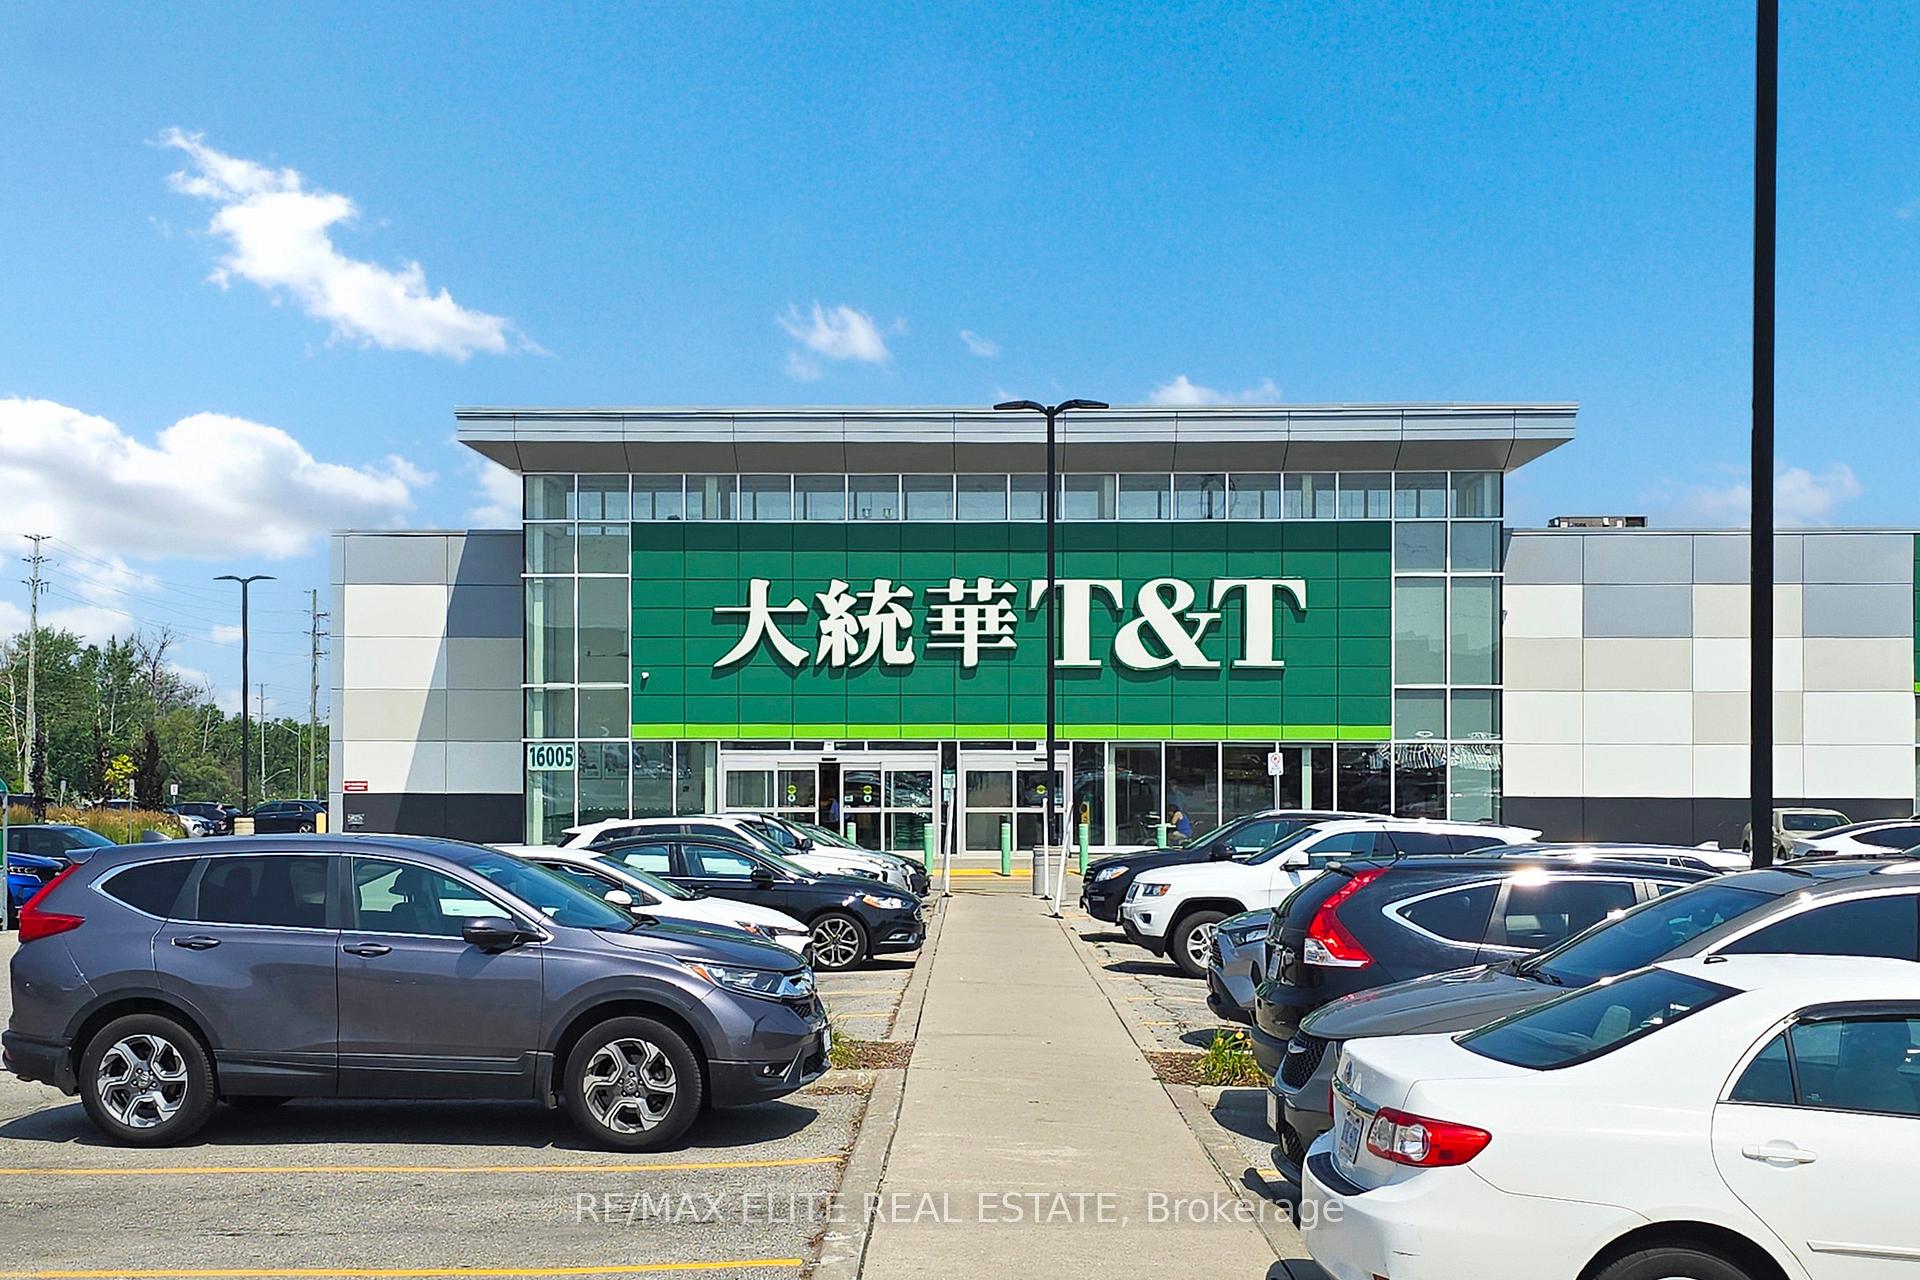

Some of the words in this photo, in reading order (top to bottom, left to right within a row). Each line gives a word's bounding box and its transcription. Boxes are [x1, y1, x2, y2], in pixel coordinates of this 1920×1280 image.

[713, 576, 1018, 668] 大統華
[1028, 577, 1307, 670] T&T
[529, 746, 574, 767] 16005
